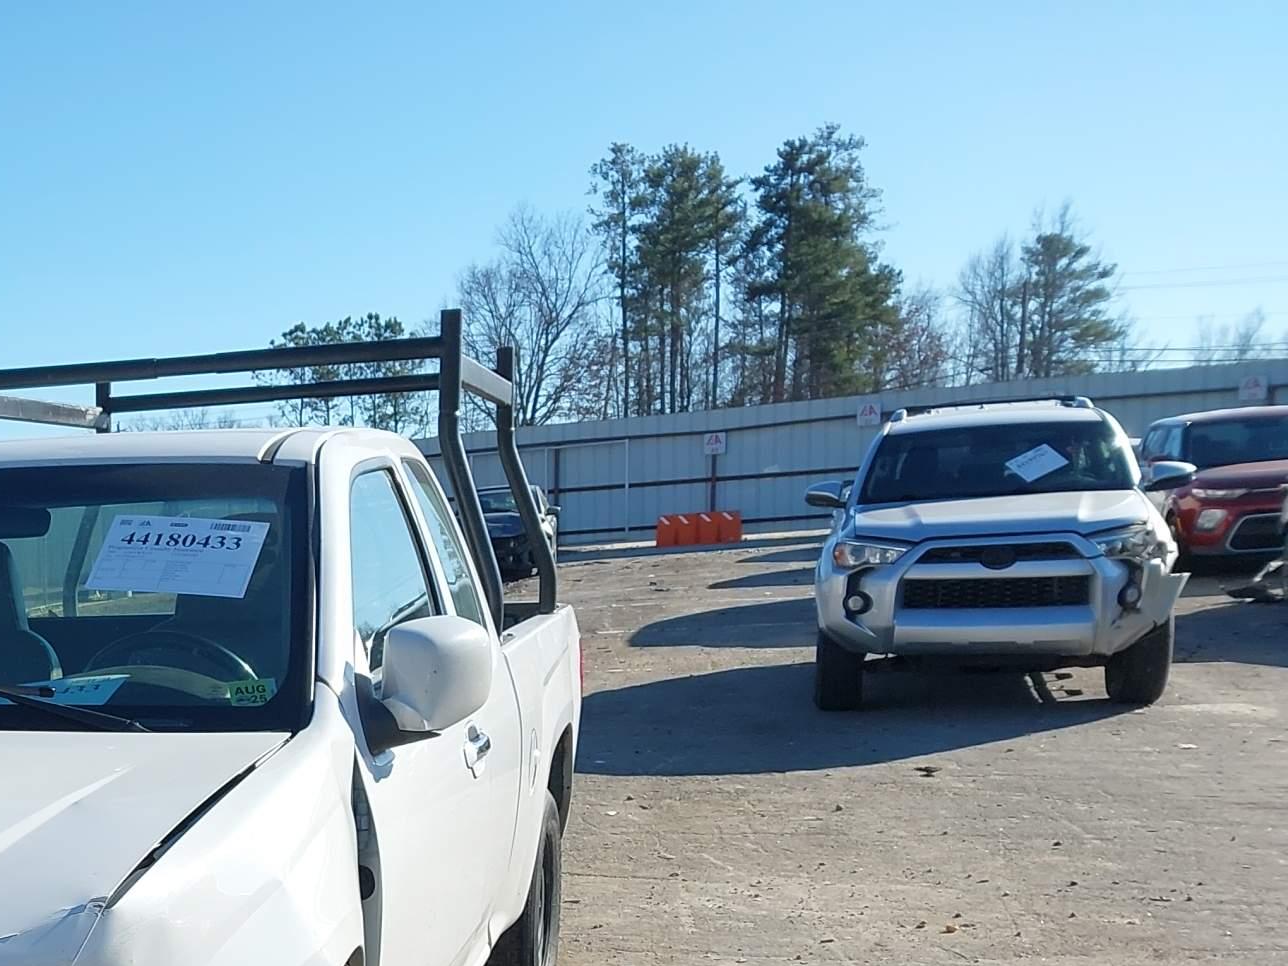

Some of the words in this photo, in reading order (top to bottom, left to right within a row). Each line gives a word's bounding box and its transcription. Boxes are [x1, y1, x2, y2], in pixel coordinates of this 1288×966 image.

[120, 531, 243, 551] 44180433
[235, 684, 266, 696] AUG
[250, 694, 268, 704] 25
